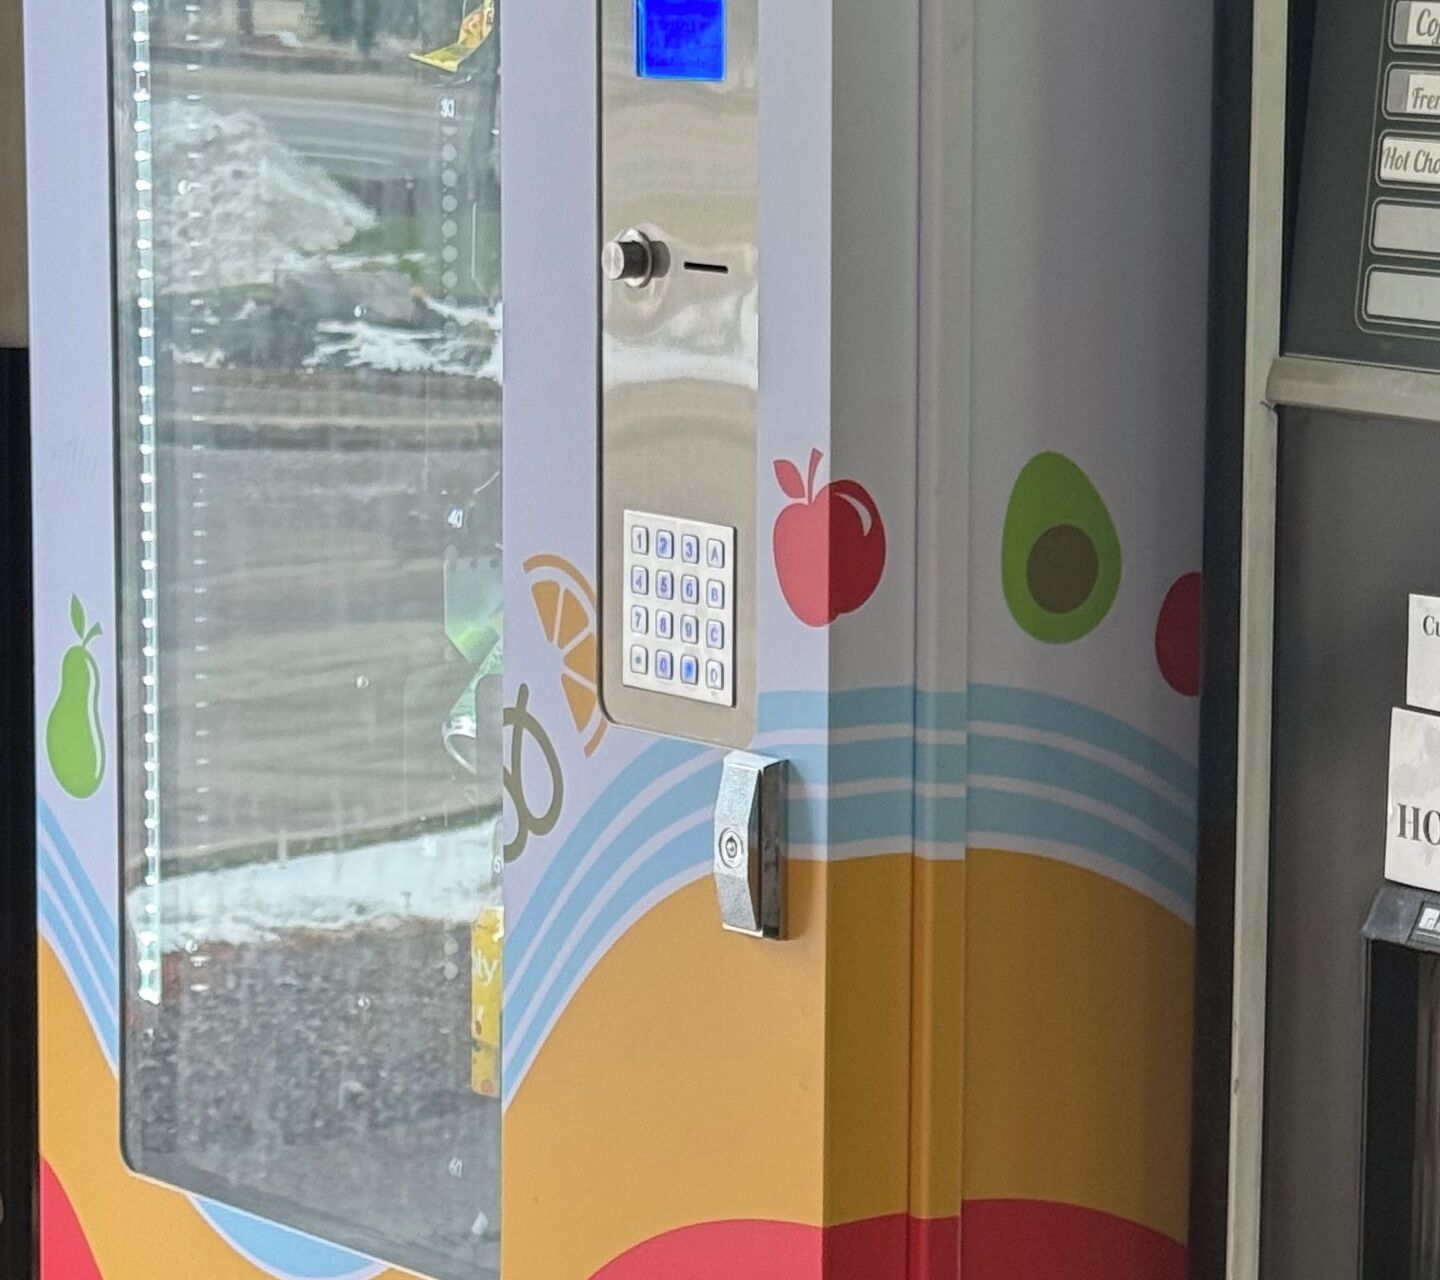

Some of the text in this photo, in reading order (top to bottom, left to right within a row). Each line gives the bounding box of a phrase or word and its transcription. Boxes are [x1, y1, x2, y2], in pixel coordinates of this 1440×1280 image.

[1383, 147, 1411, 172] Hot
[659, 538, 668, 554] 2
[686, 542, 694, 559] 3
[711, 546, 719, 562] A
[660, 579, 668, 594] 5
[686, 581, 694, 599] 6
[711, 585, 720, 602] B
[635, 612, 719, 643] 7 8 9 C
